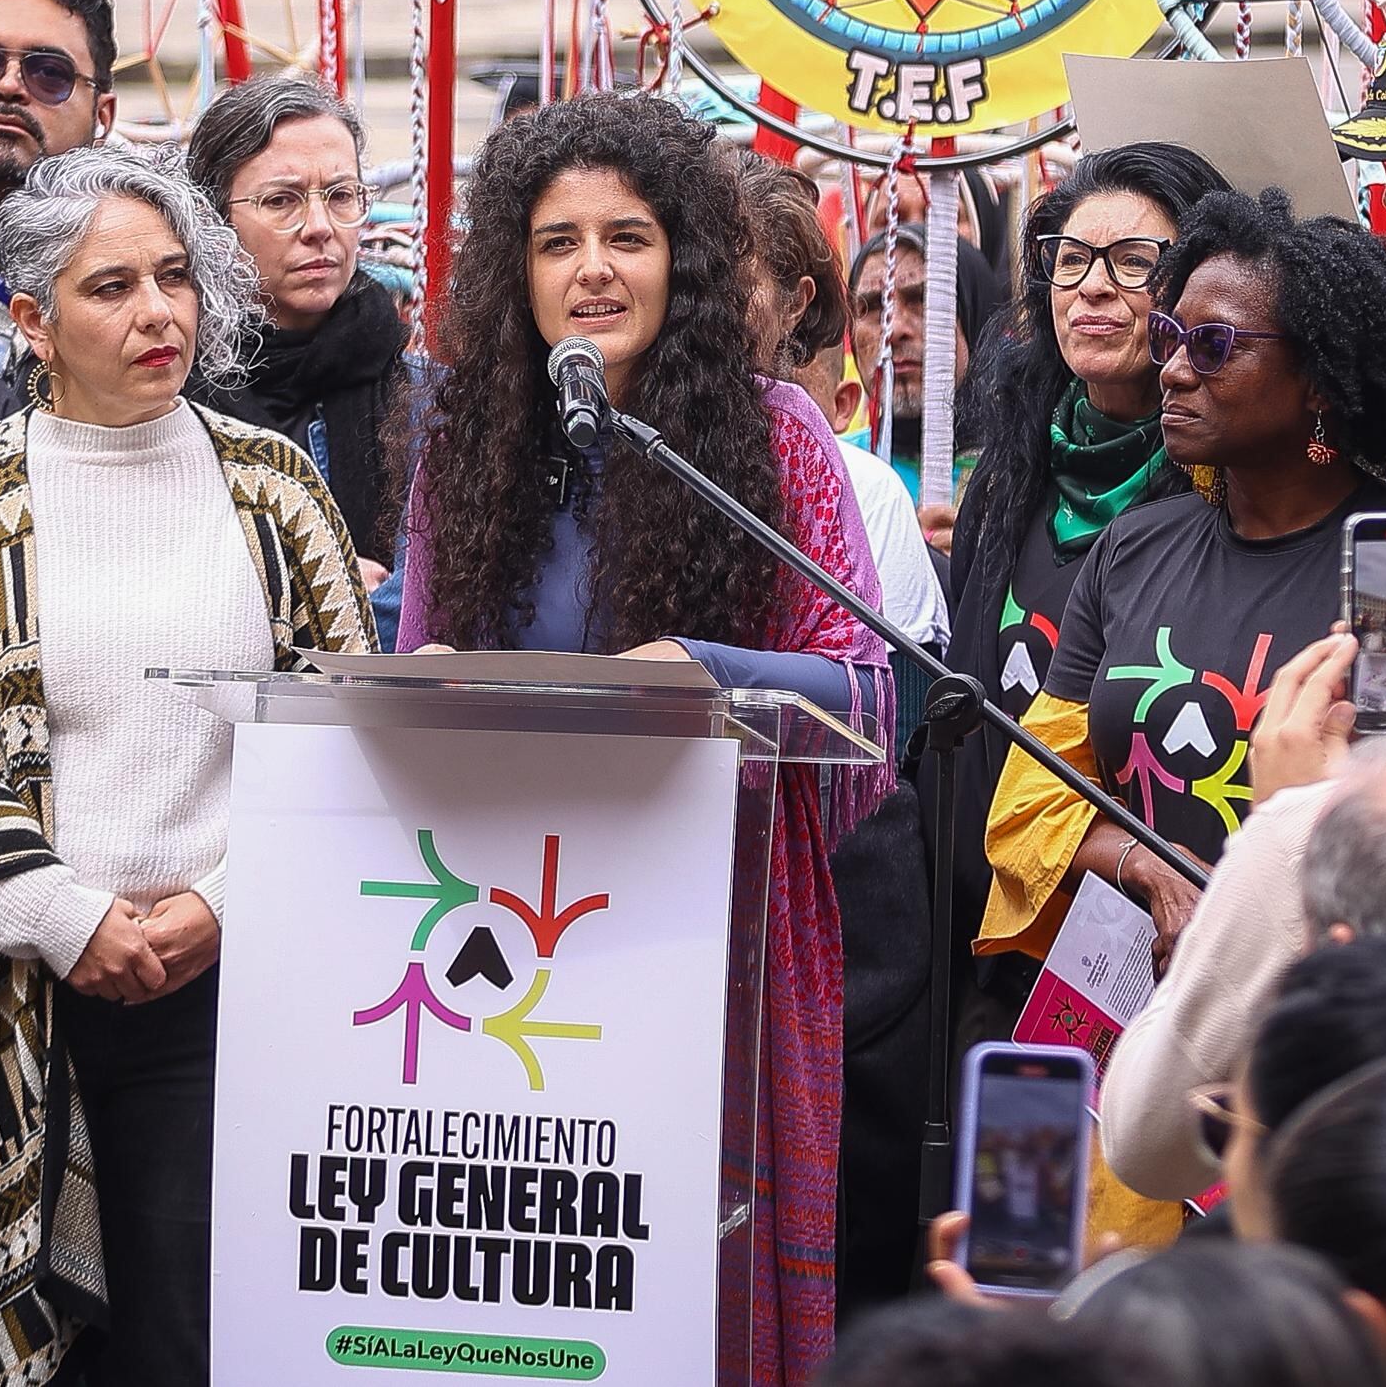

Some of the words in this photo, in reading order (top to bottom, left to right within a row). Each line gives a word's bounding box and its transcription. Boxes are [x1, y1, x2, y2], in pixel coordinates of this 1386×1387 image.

[847, 51, 988, 123] T.E.F
[326, 1103, 617, 1168] FORTALECIMIENTO
[288, 1153, 388, 1224] LEY
[397, 1159, 651, 1241] GENERAL
[298, 1225, 370, 1295] DE
[380, 1230, 635, 1312] CULTURA
[335, 1334, 595, 1370] #SíALaLeyQueNosUne
